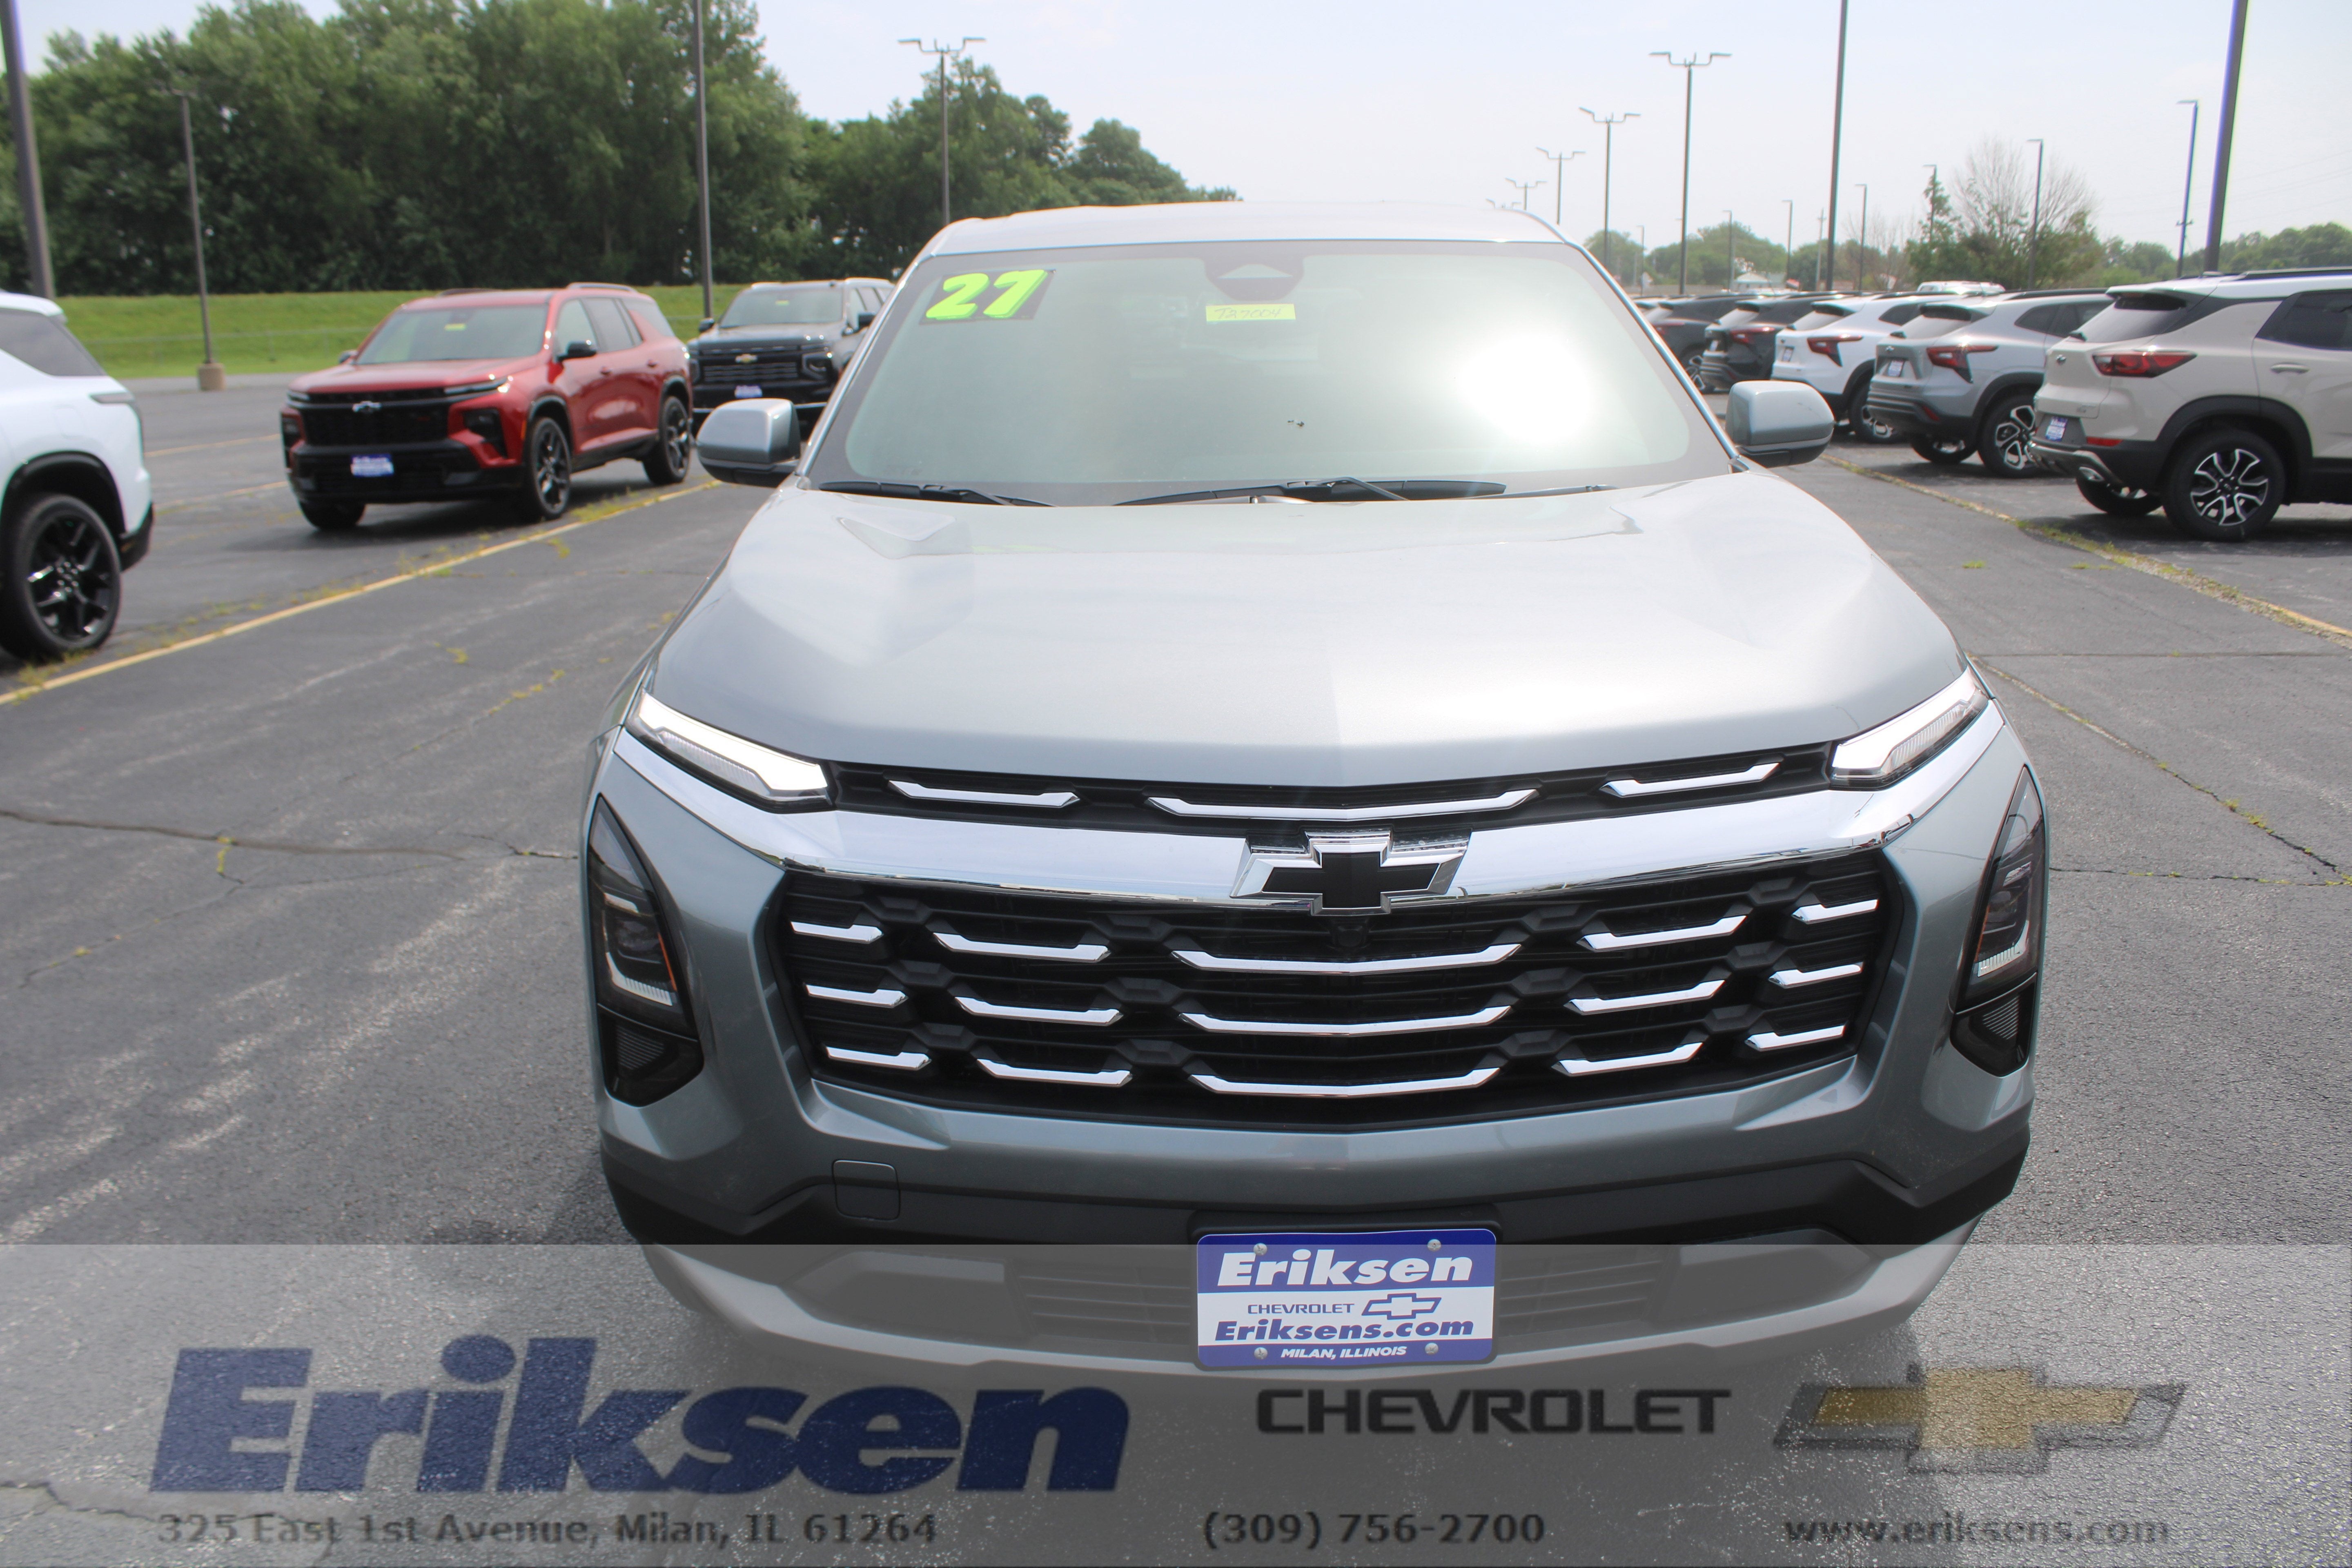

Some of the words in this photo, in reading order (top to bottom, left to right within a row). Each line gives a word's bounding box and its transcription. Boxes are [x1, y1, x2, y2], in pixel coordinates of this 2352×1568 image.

[926, 269, 1049, 320] 27
[1217, 1248, 1473, 1286] Eriksen
[1247, 1303, 1355, 1315] CHEVROLET
[1215, 1318, 1474, 1341] Eriksens.com
[1281, 1348, 1336, 1360] MILAN,
[1339, 1345, 1407, 1358] ILLINOIS
